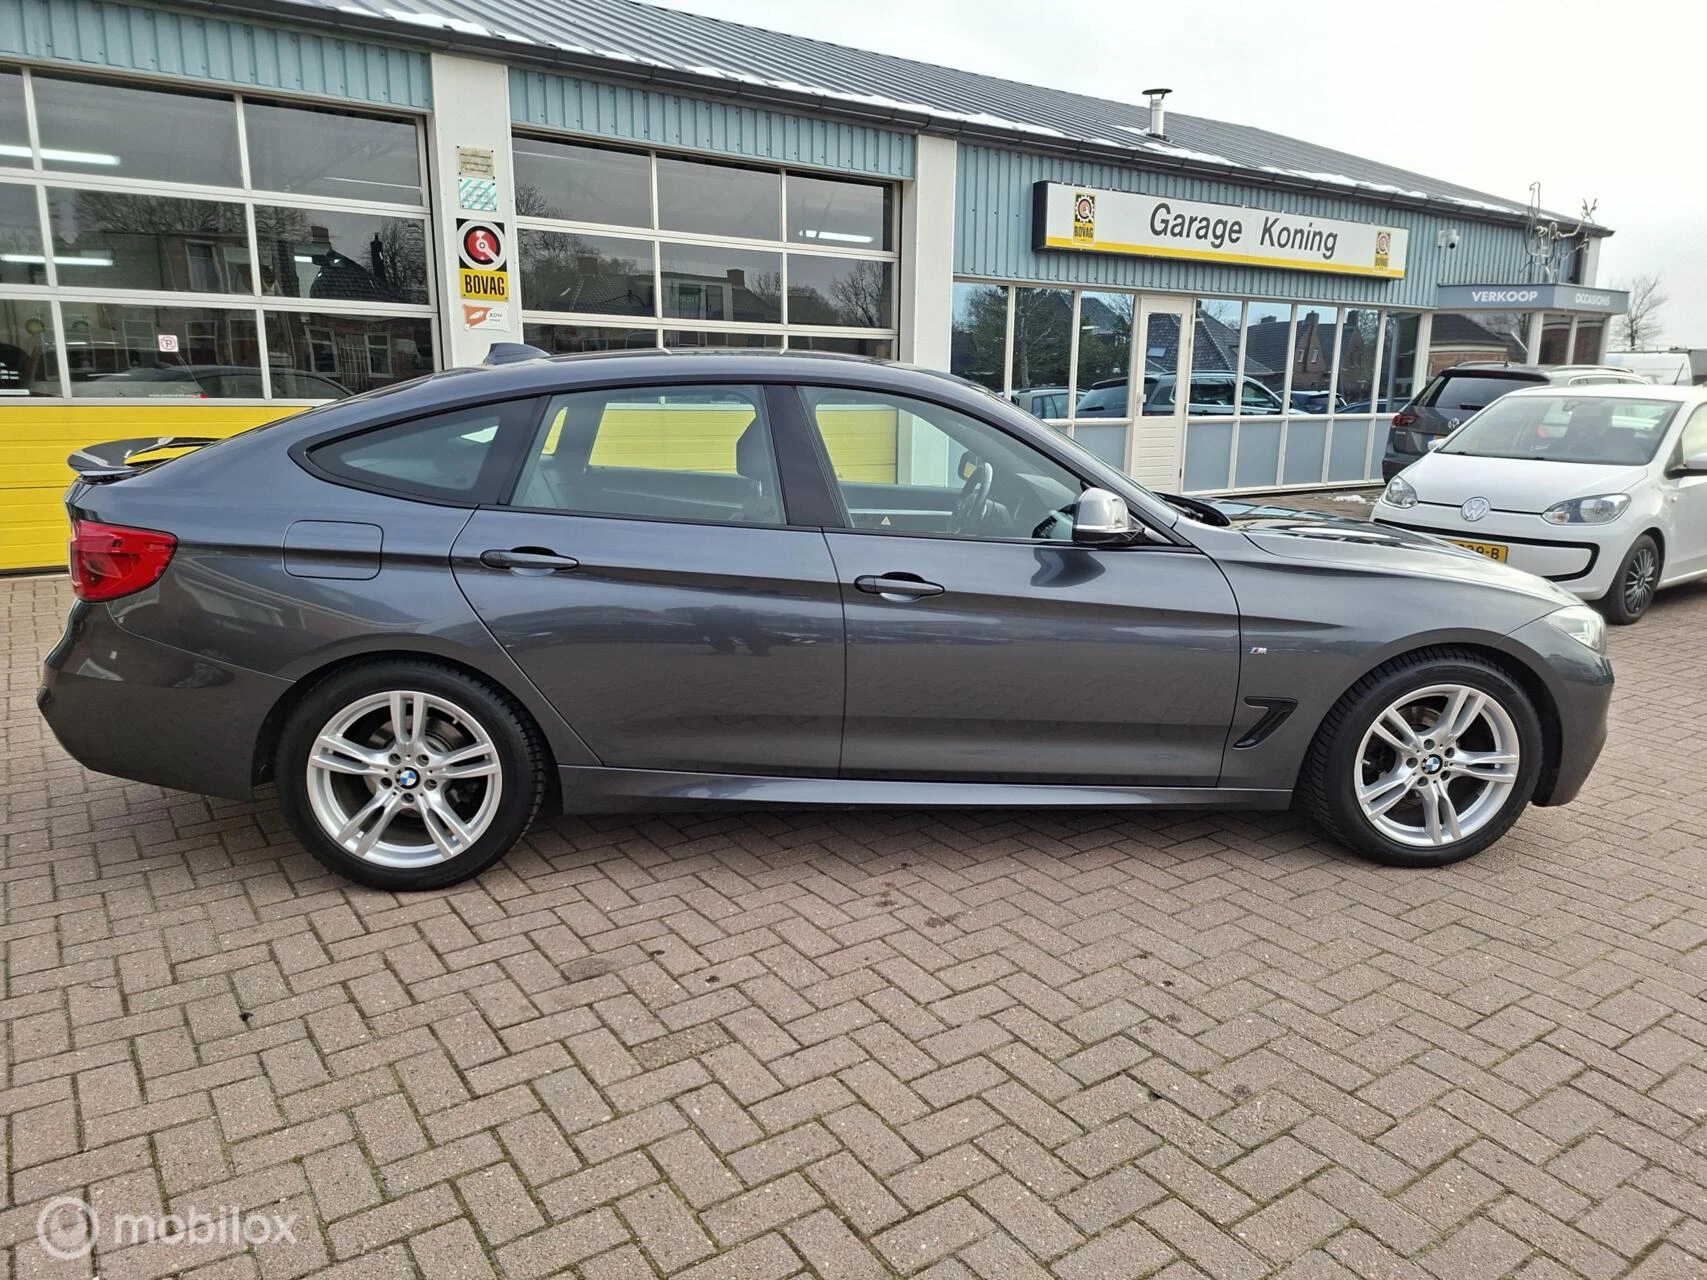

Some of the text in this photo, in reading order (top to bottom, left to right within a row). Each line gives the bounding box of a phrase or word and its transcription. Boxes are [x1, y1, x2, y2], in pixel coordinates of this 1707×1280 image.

[1074, 225, 1094, 239] BOVAG
[1150, 202, 1338, 261] Garage Koning
[464, 274, 505, 297] BOVAG
[1471, 290, 1539, 303] VERKOOP
[1575, 292, 1611, 307] OCCASIONS
